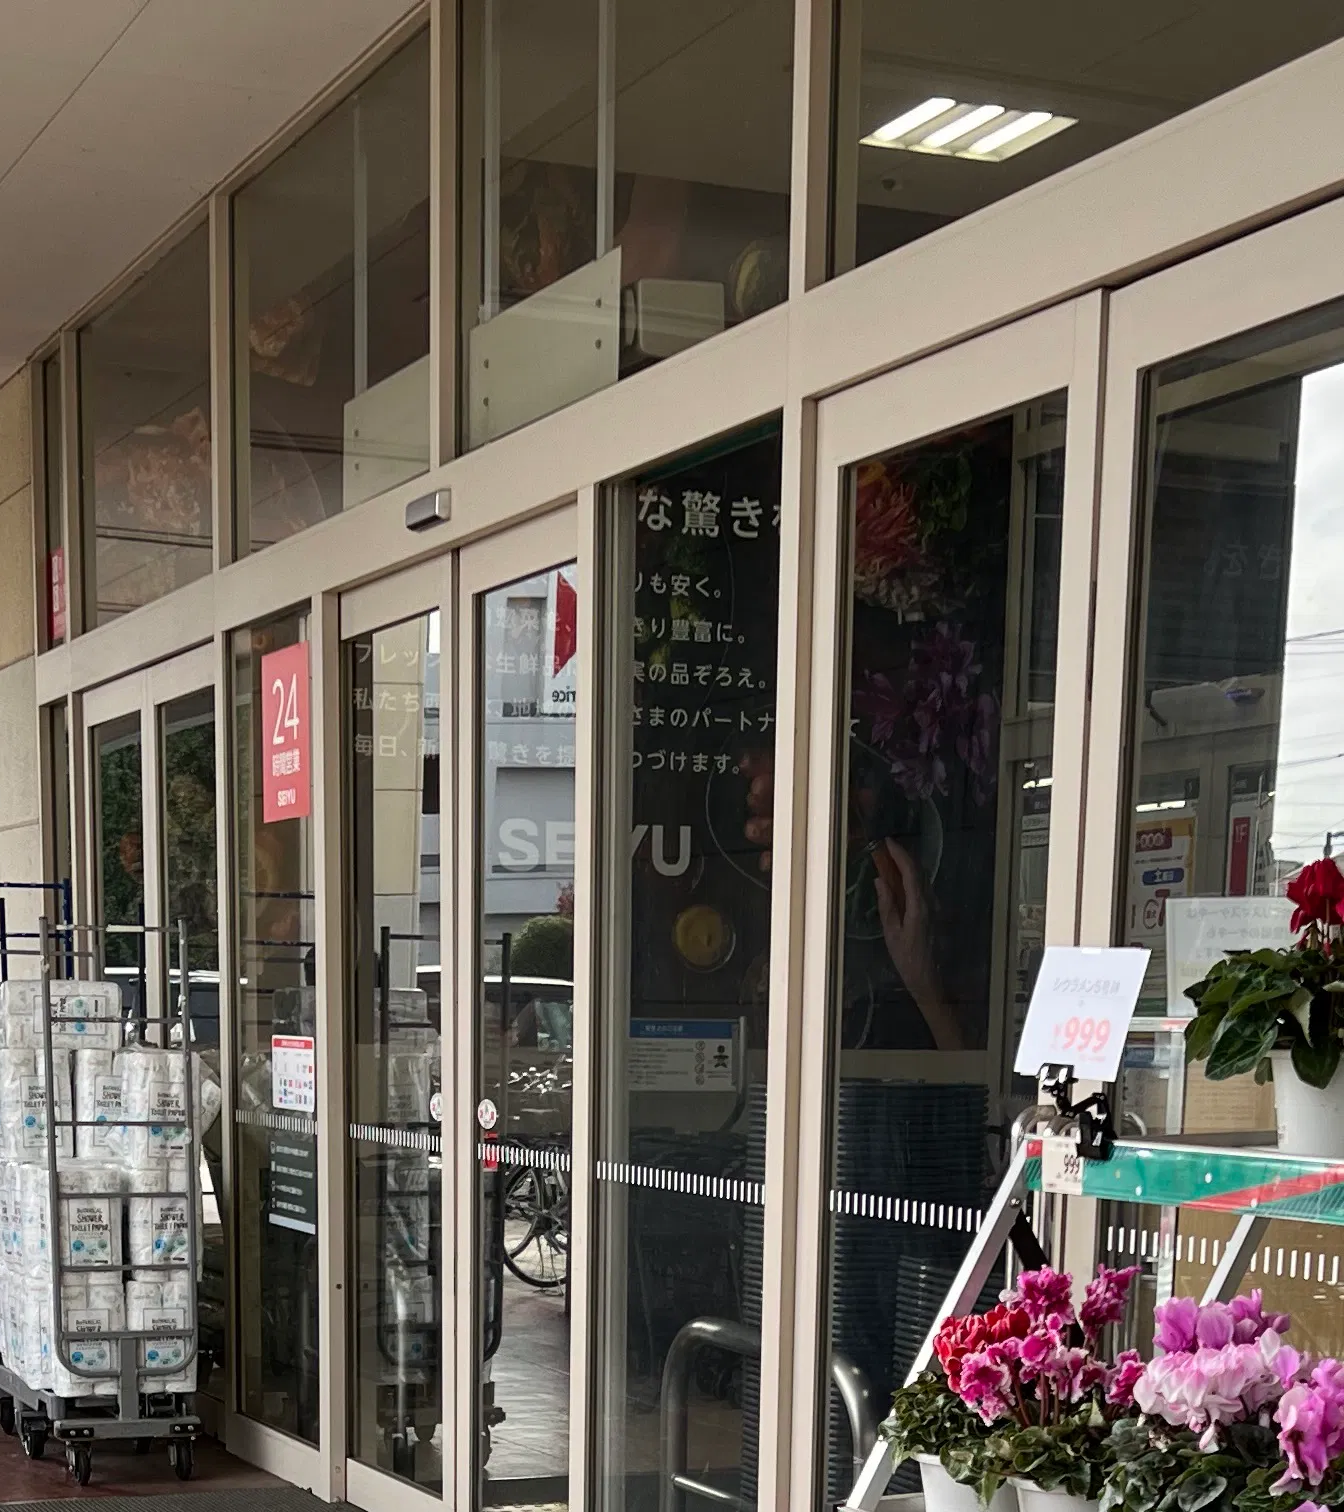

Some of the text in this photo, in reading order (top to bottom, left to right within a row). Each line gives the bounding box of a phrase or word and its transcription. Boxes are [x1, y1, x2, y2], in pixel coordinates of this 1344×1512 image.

[638, 489, 781, 539] な驚き
[272, 673, 300, 745] 24
[277, 788, 296, 808] SEIYU
[1063, 1153, 1080, 1175] 999
[77, 1213, 103, 1224] SHOWER
